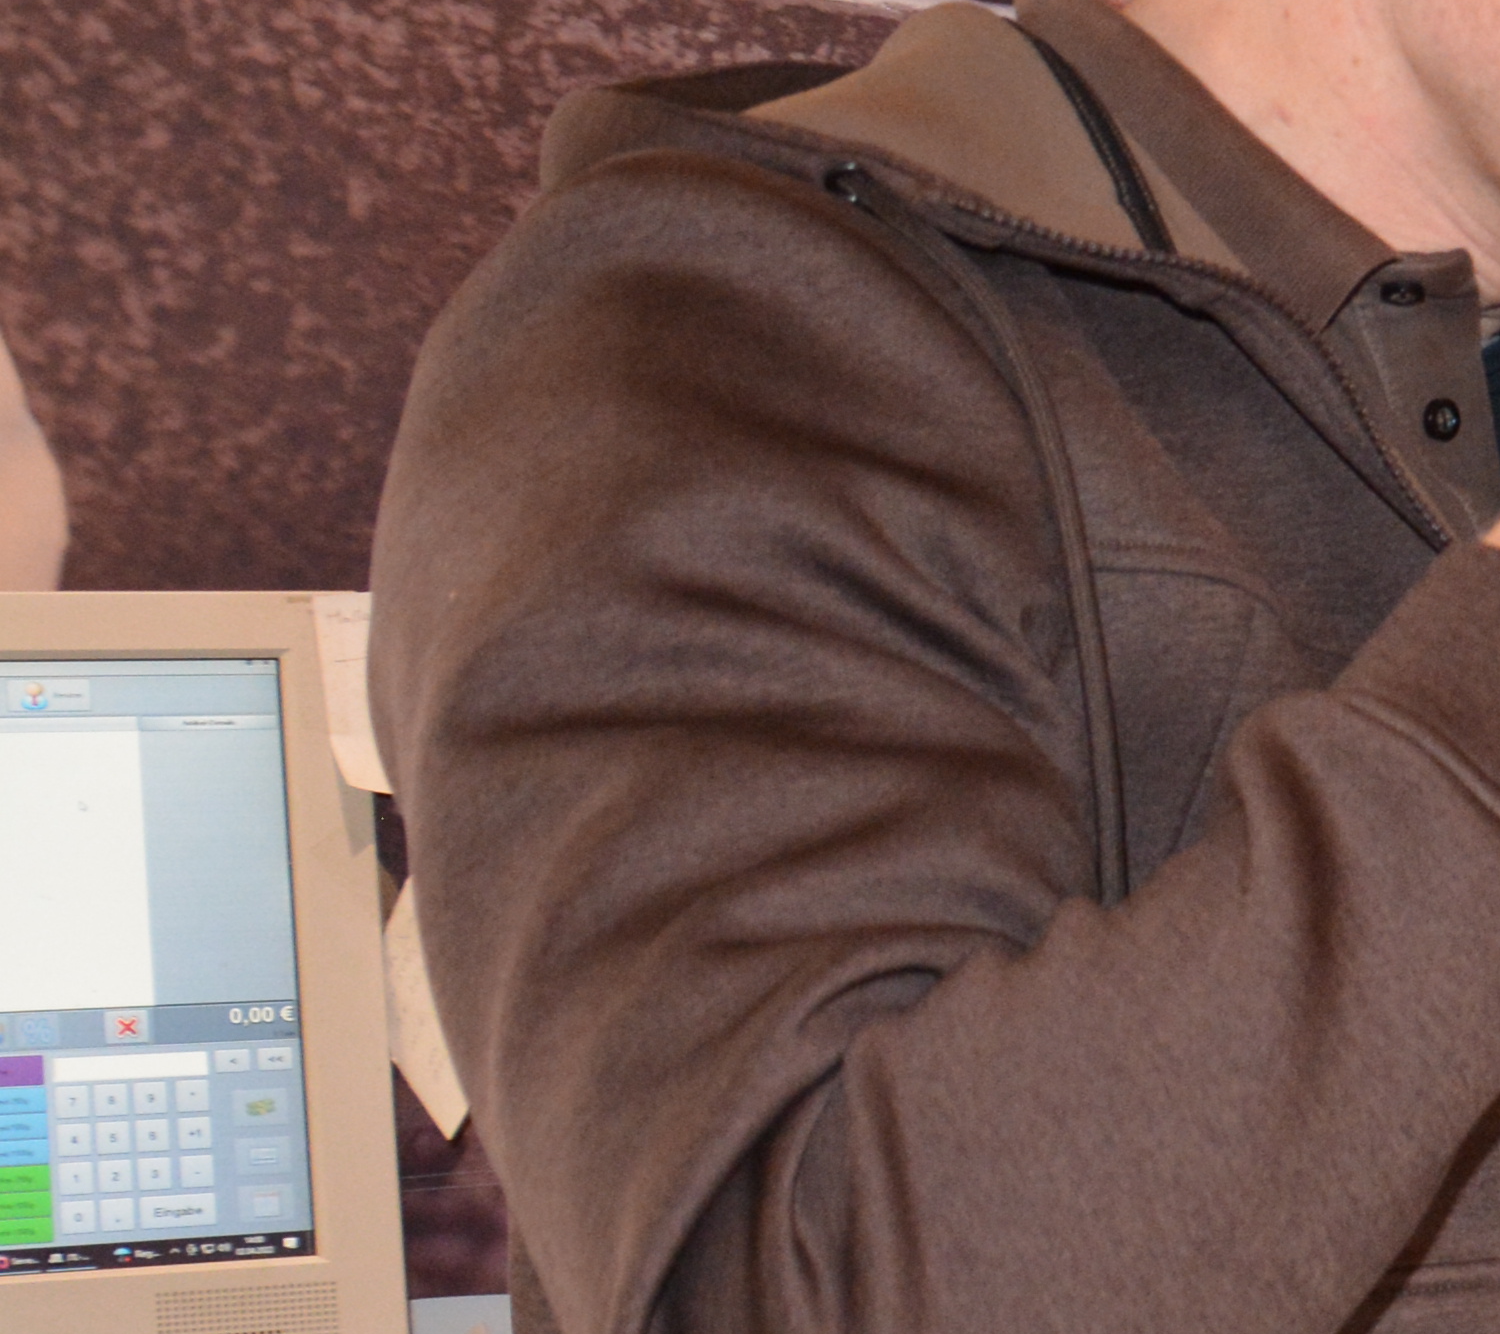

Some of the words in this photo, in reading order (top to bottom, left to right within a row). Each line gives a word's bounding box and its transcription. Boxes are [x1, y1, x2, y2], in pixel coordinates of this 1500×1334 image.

[228, 1007, 275, 1027] 0,00
[278, 1005, 296, 1022] €
[153, 1205, 205, 1219] Eingabe
